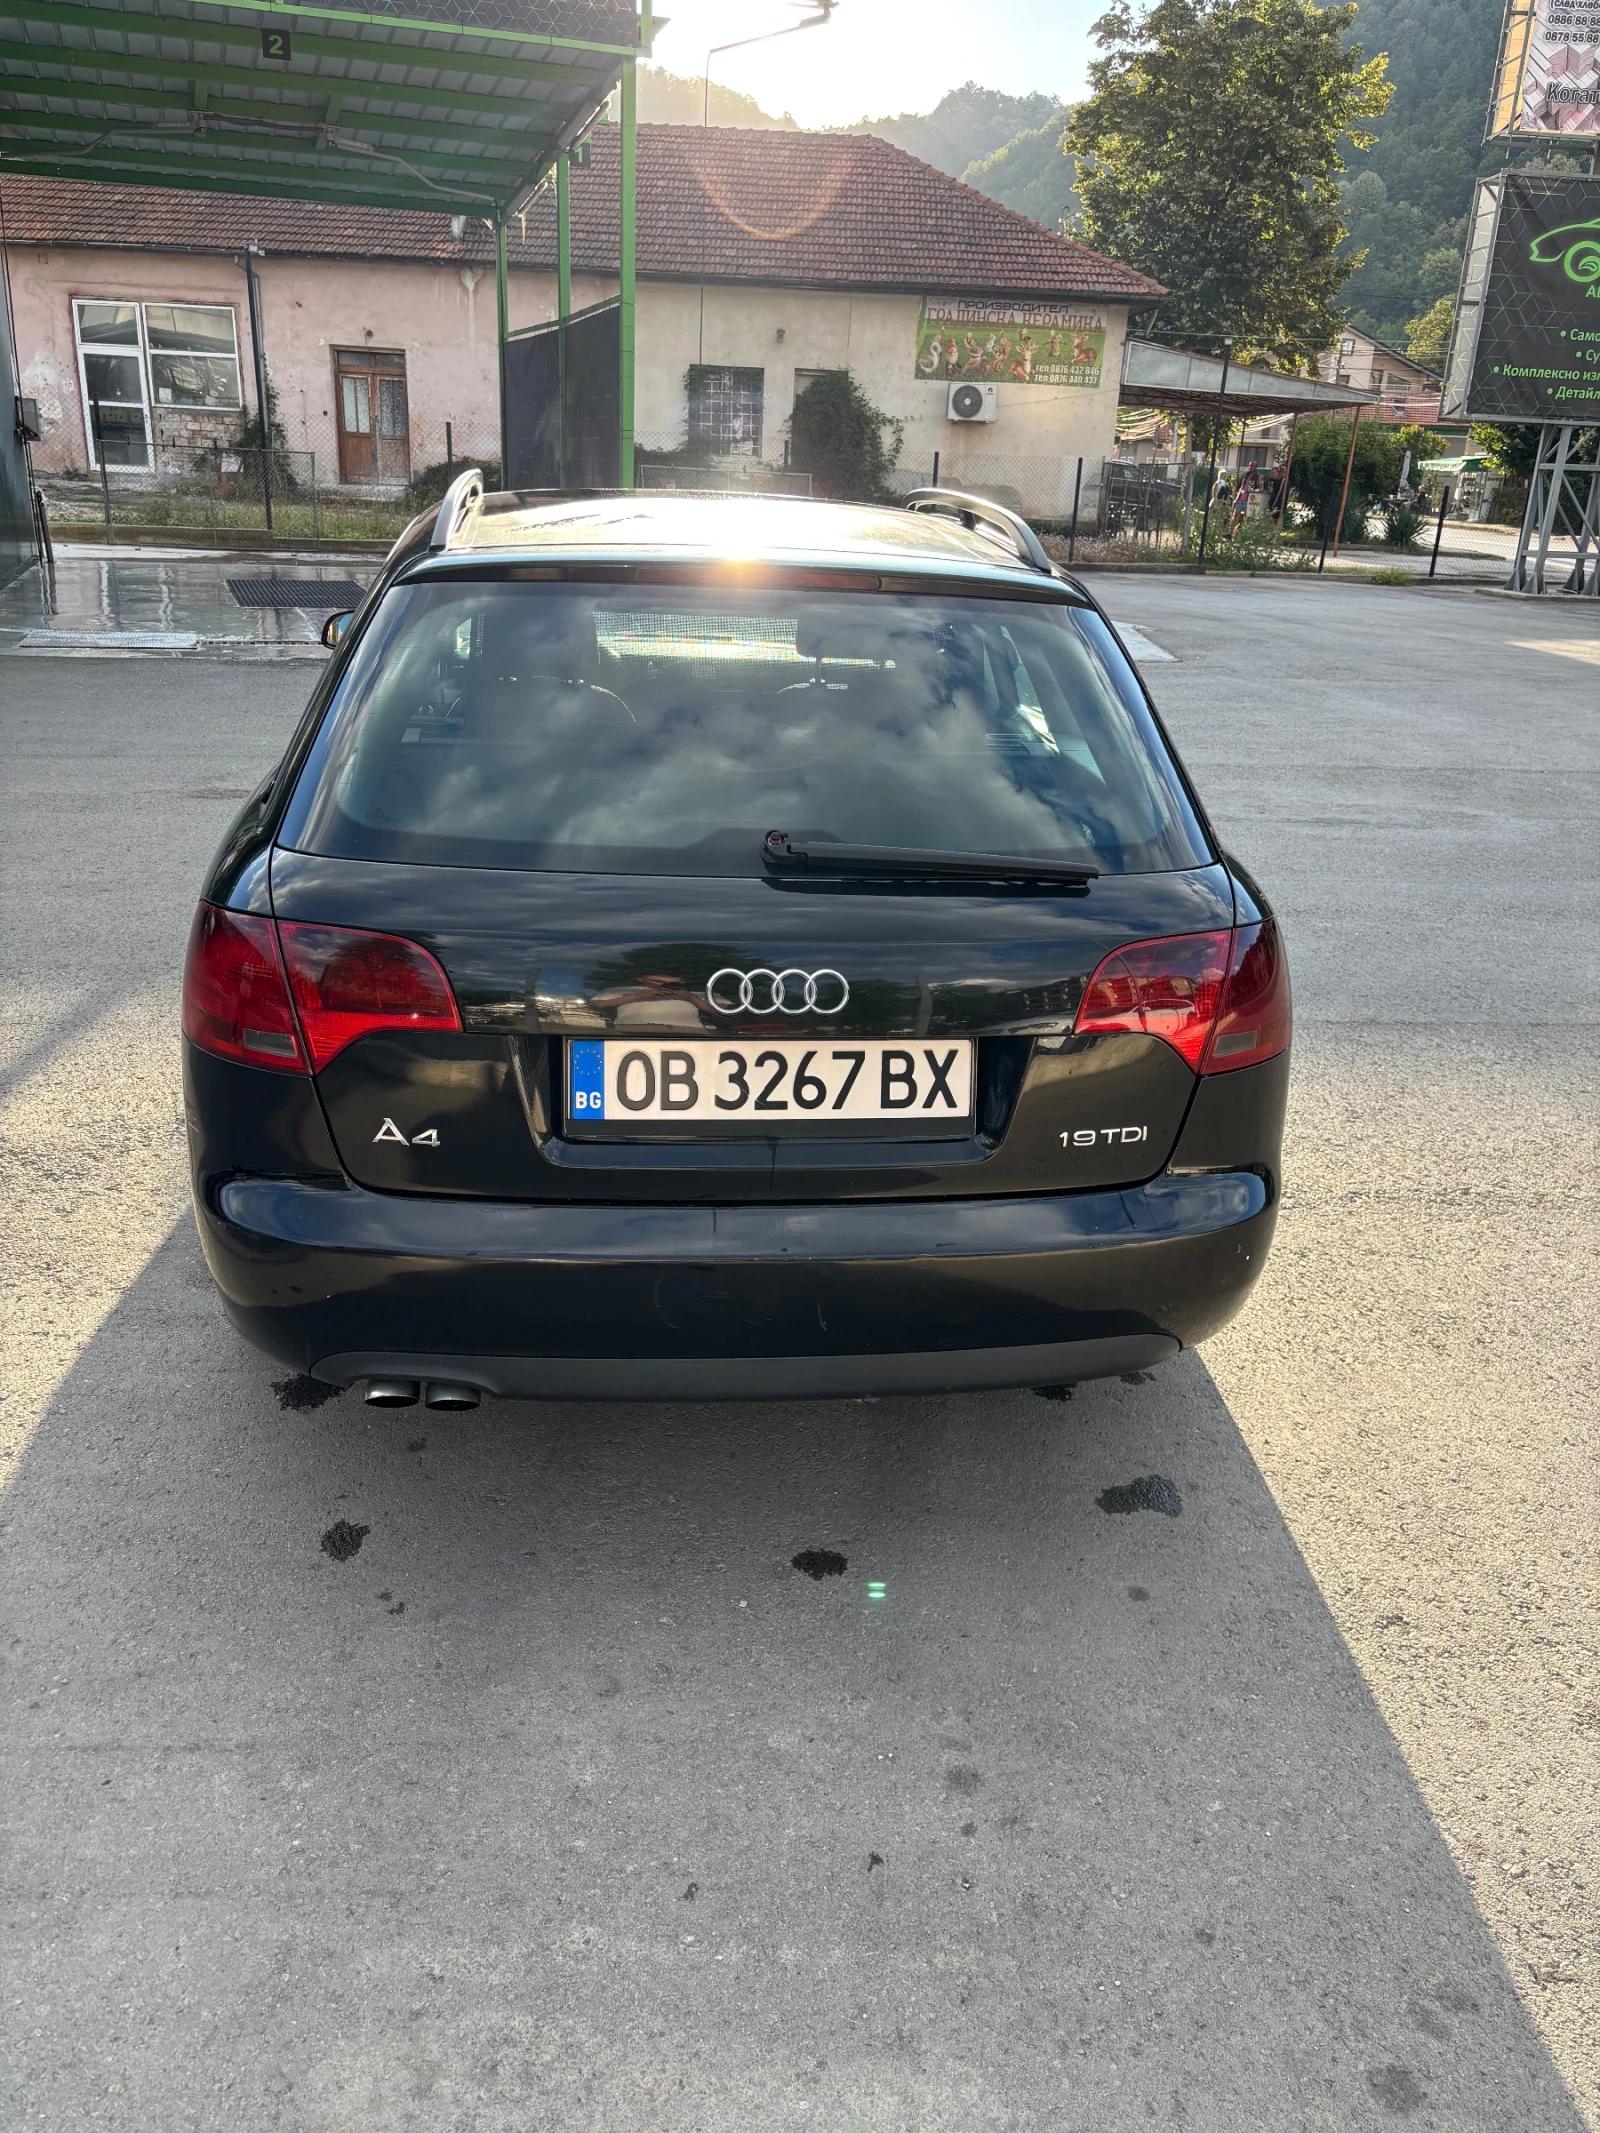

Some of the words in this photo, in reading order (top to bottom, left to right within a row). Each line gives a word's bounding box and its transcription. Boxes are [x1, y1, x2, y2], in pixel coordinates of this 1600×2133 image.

[1577, 1, 1600, 9] хлеб
[1548, 14, 1573, 25] 0886
[1575, 15, 1588, 26] 88
[269, 34, 283, 55] 2
[1545, 31, 1570, 42] 0878
[1572, 33, 1585, 42] 55
[1586, 33, 1599, 43] 88
[575, 146, 583, 163] 1
[957, 300, 1069, 314] ПРОИЗВОДИТЕЛ
[926, 307, 1017, 329] ГРАДИНСКА
[1021, 312, 1103, 333] КЕРАМИКА
[1069, 366, 1084, 375] 432
[1085, 366, 1100, 376] 846
[1503, 364, 1580, 380] Комплексно
[1068, 375, 1083, 384] 440
[1084, 376, 1097, 385] 437
[714, 1050, 866, 1111] 3267
[880, 1049, 959, 1109] BX
[575, 1091, 602, 1109] BG
[371, 1117, 441, 1147] A4
[1100, 1126, 1148, 1144] TDI
